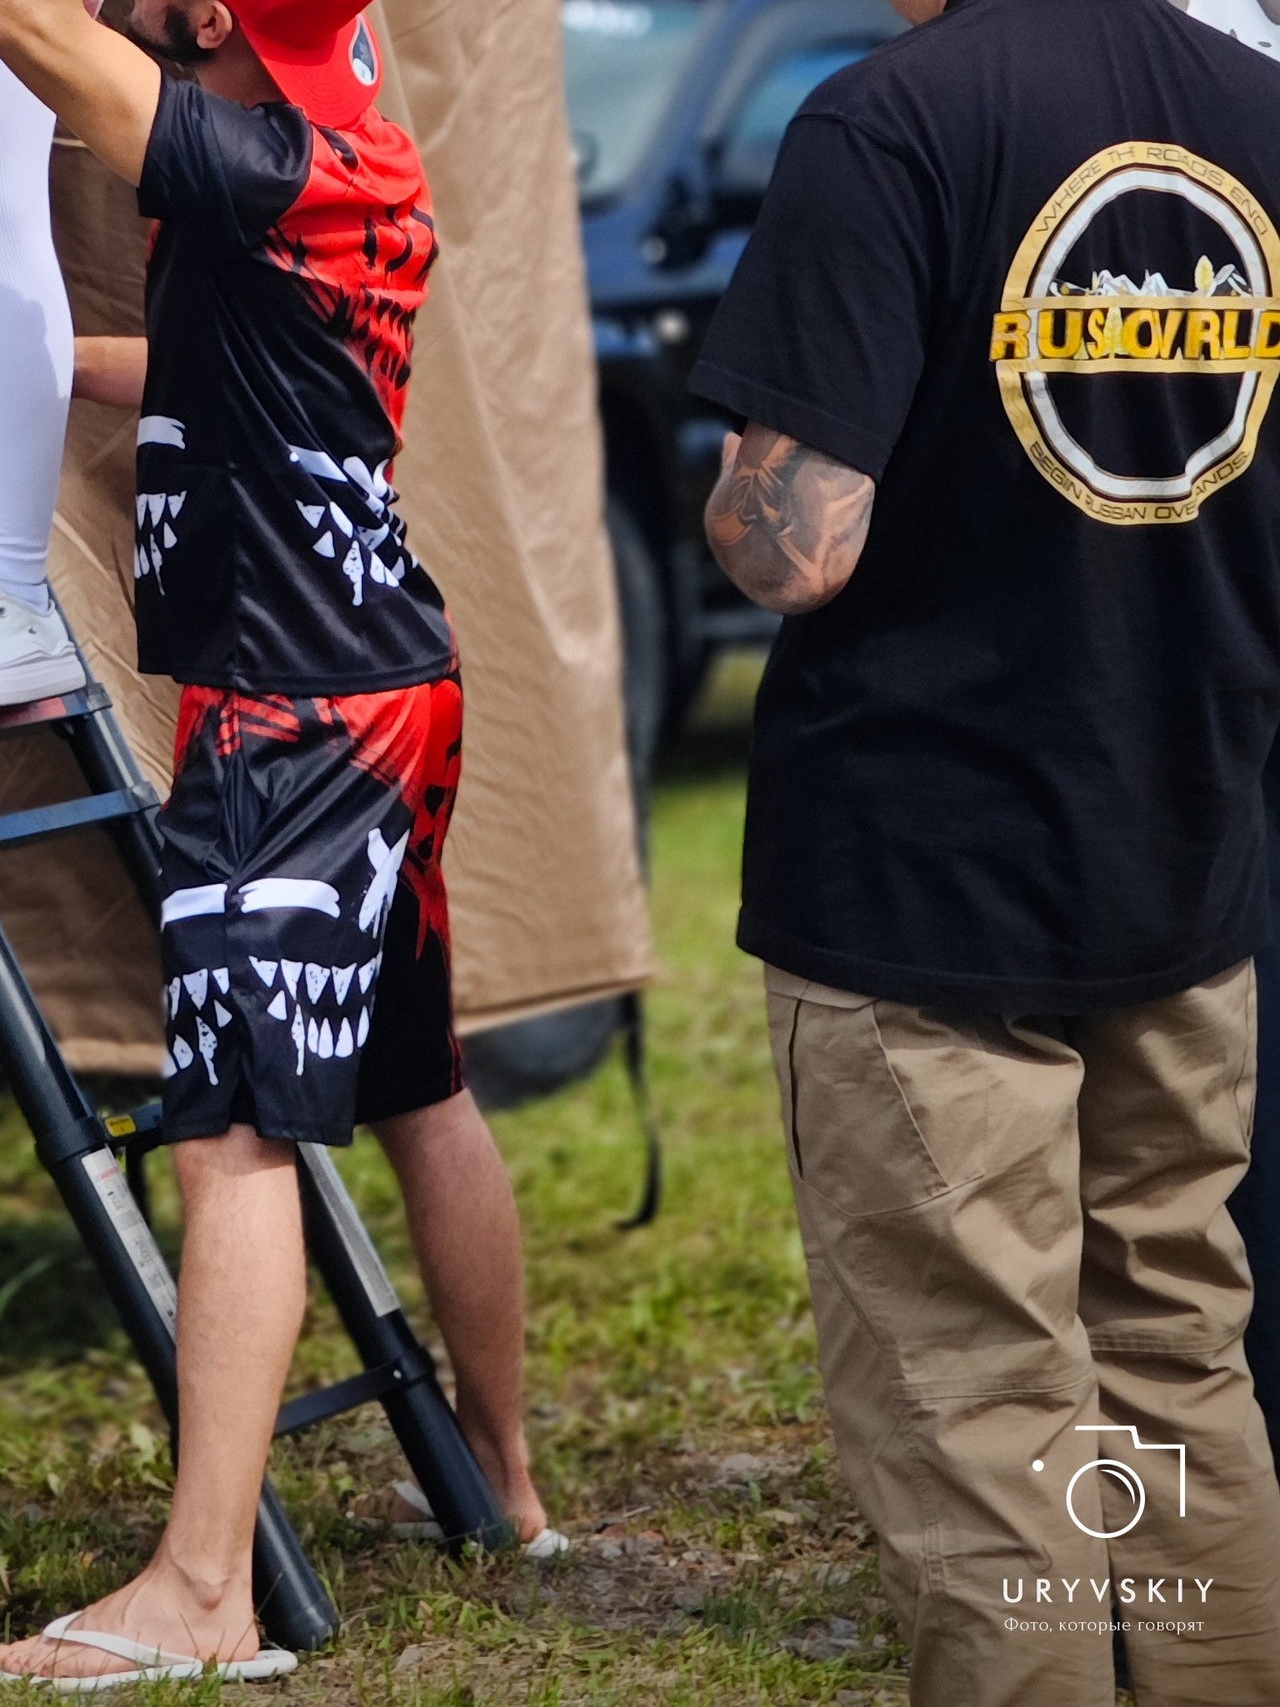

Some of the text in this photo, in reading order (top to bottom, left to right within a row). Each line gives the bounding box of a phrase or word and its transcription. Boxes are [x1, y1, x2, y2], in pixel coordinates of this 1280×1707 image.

[1035, 159, 1103, 233] WHERE
[1146, 146, 1226, 187] ROADS
[1229, 186, 1269, 236] END
[1029, 440, 1249, 520] BEGIN RUSSAN OVEANDS
